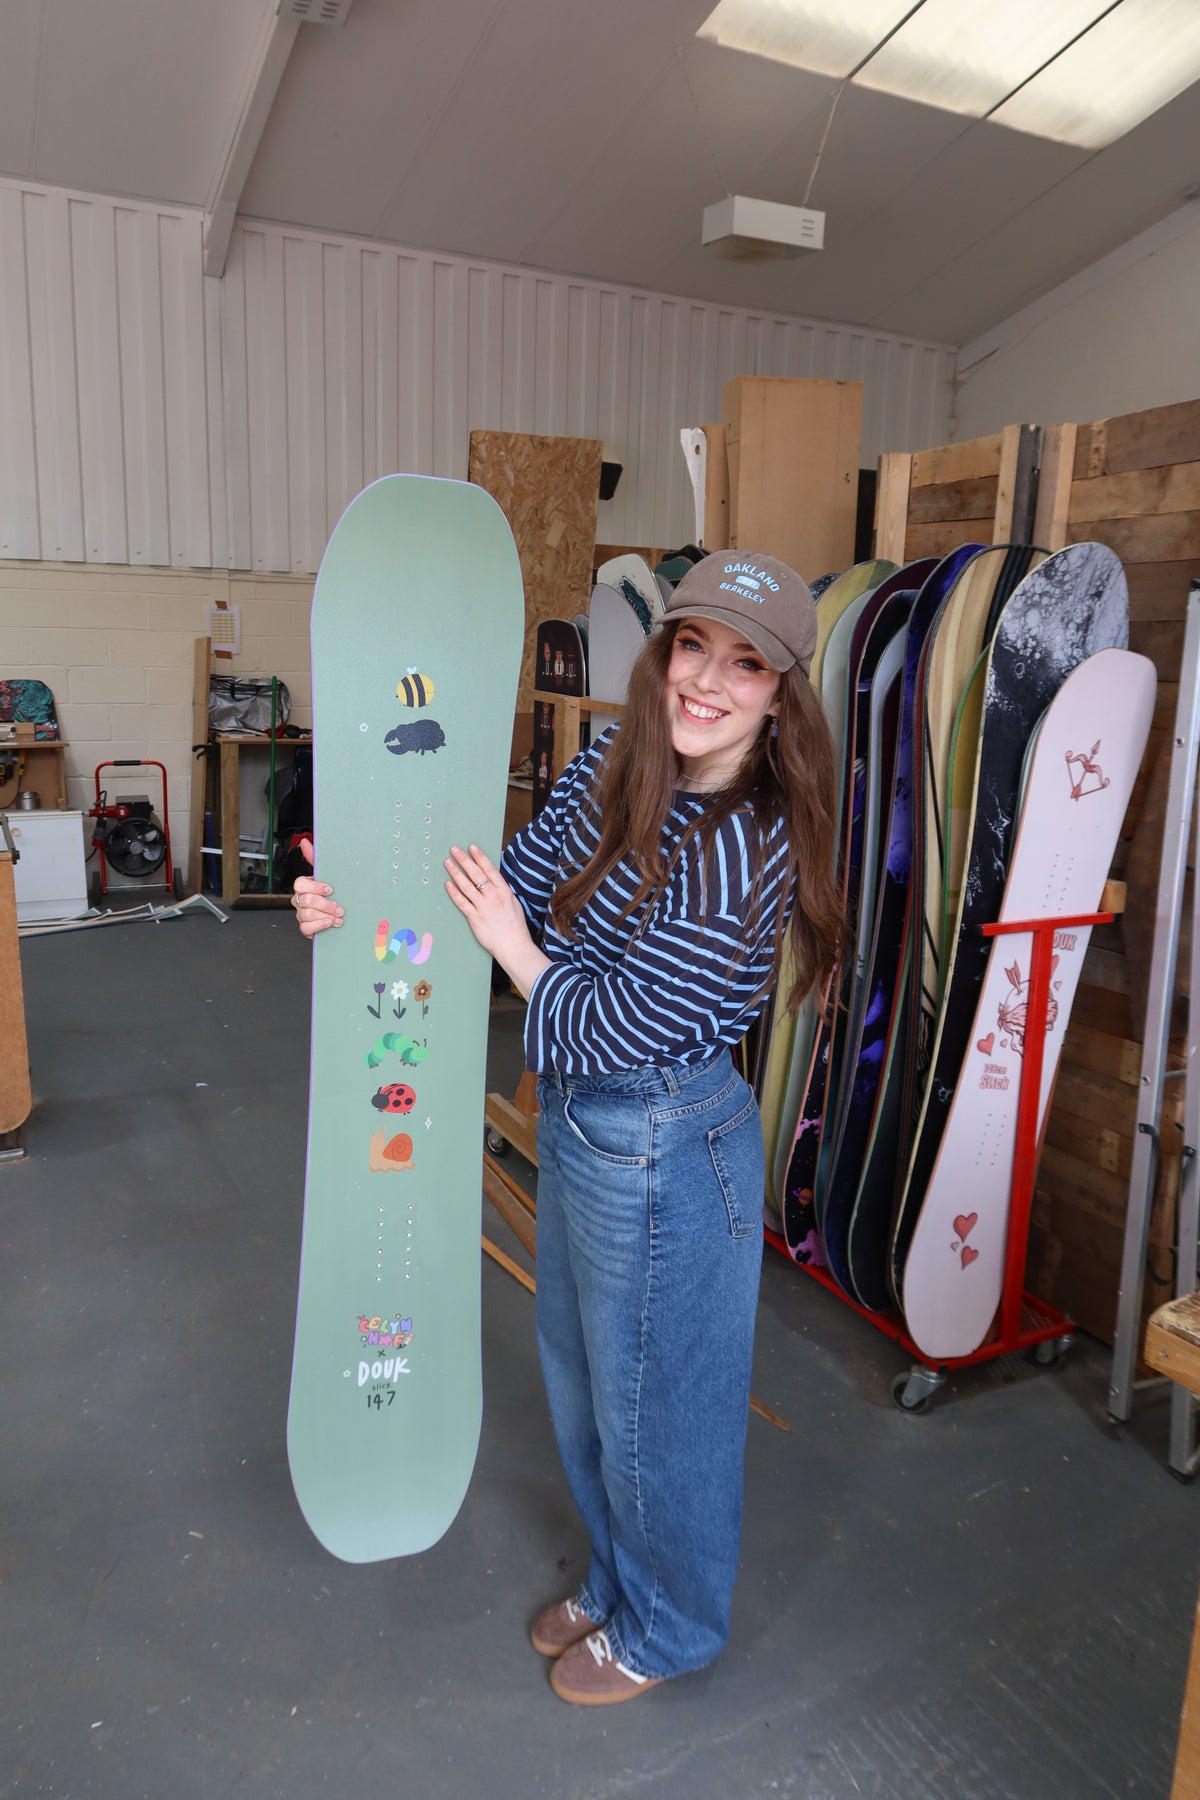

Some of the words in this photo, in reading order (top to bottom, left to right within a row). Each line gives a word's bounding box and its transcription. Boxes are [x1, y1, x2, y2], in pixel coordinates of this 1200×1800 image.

[724, 563, 780, 592] OAKLAND
[719, 582, 766, 604] BERKELEY
[1053, 931, 1078, 952] OUK
[358, 1315, 413, 1335] CELYN
[358, 1357, 411, 1387] DOUK
[367, 1390, 396, 1411] 147
